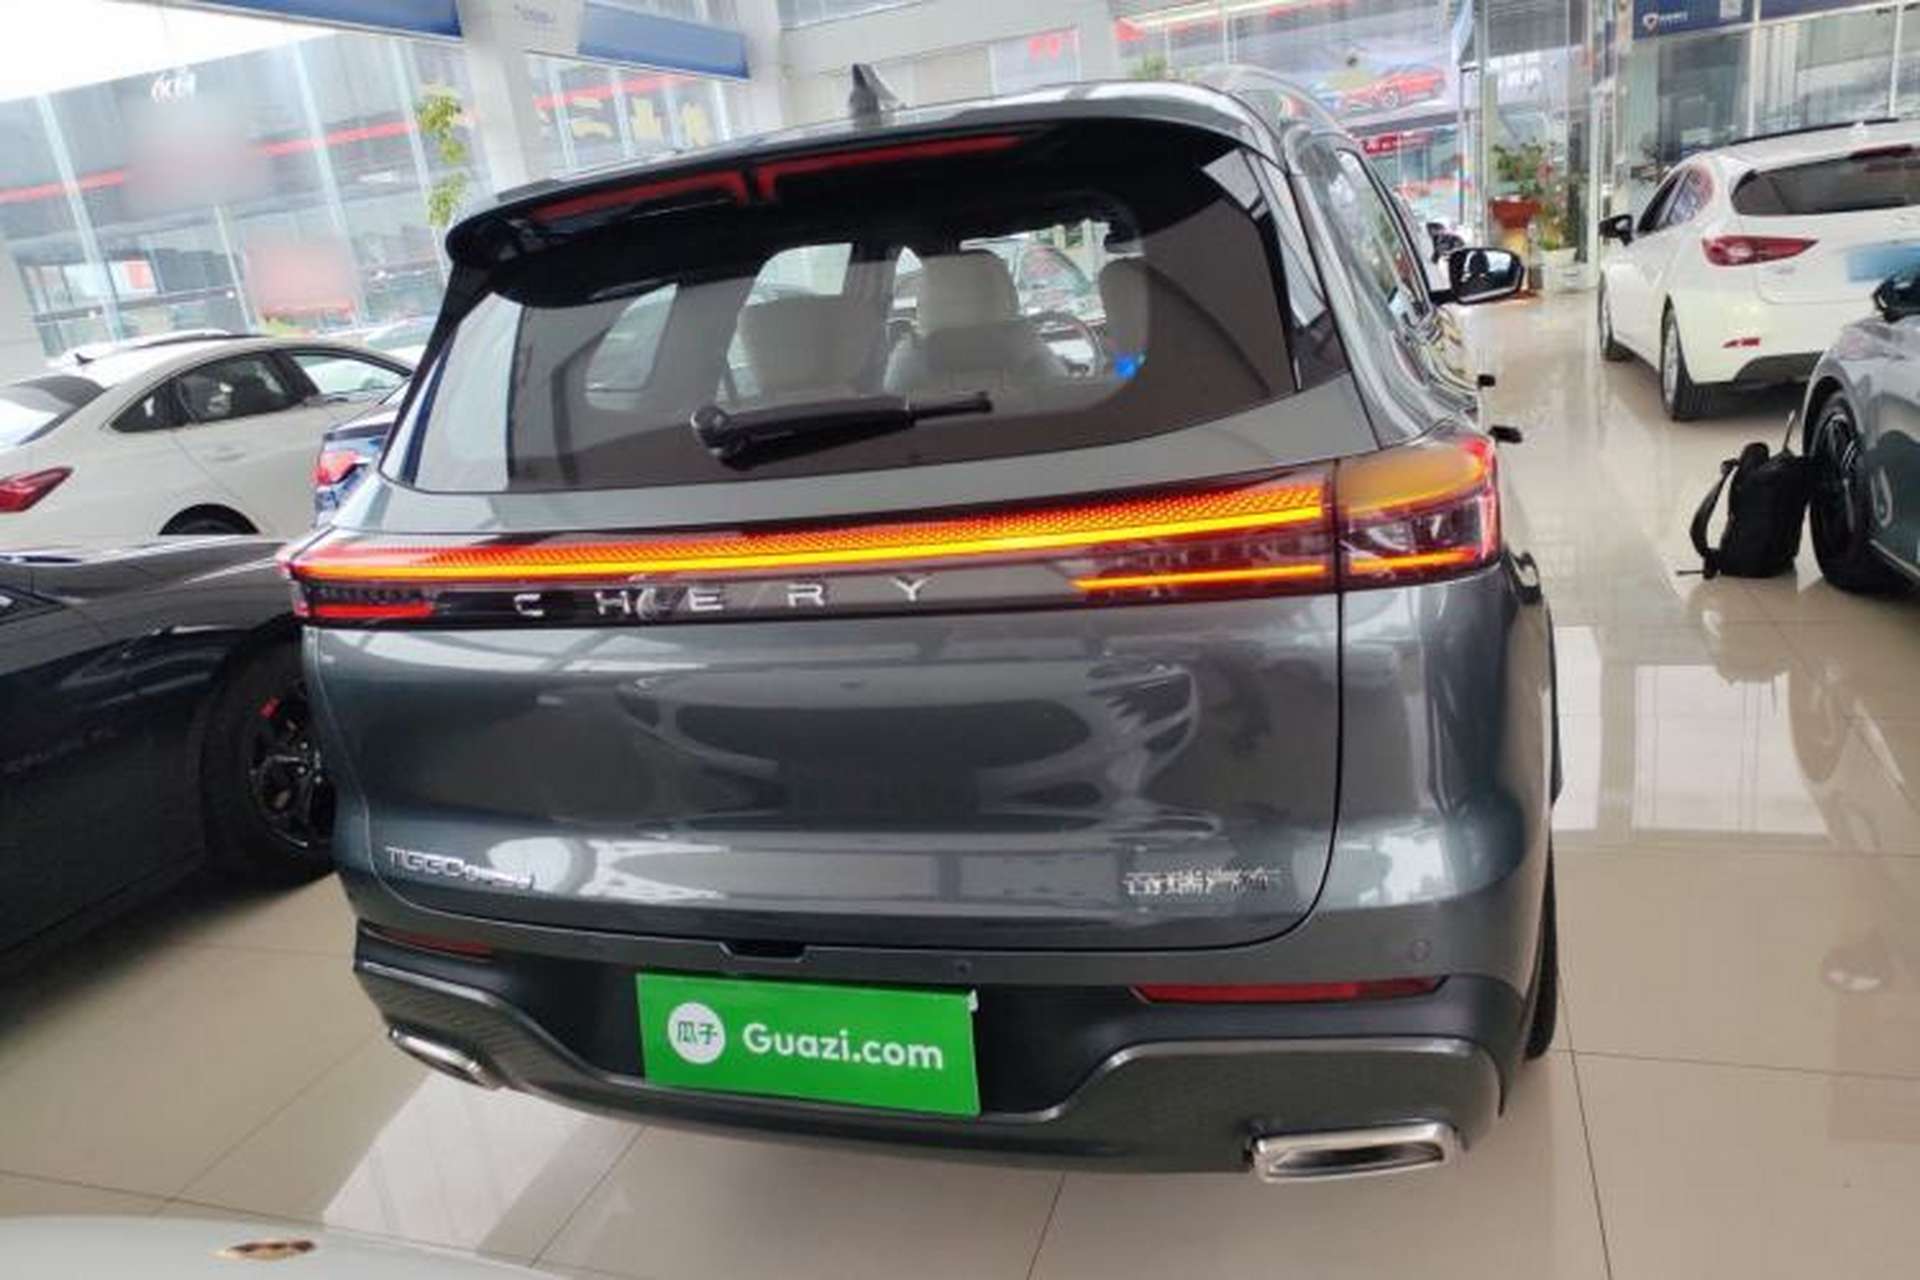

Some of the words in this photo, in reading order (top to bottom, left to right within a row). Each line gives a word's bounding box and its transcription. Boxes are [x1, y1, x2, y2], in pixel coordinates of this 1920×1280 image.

[513, 574, 931, 618] CHERY
[676, 1019, 719, 1046] 瓜子
[742, 1021, 944, 1070] Guazi.com
